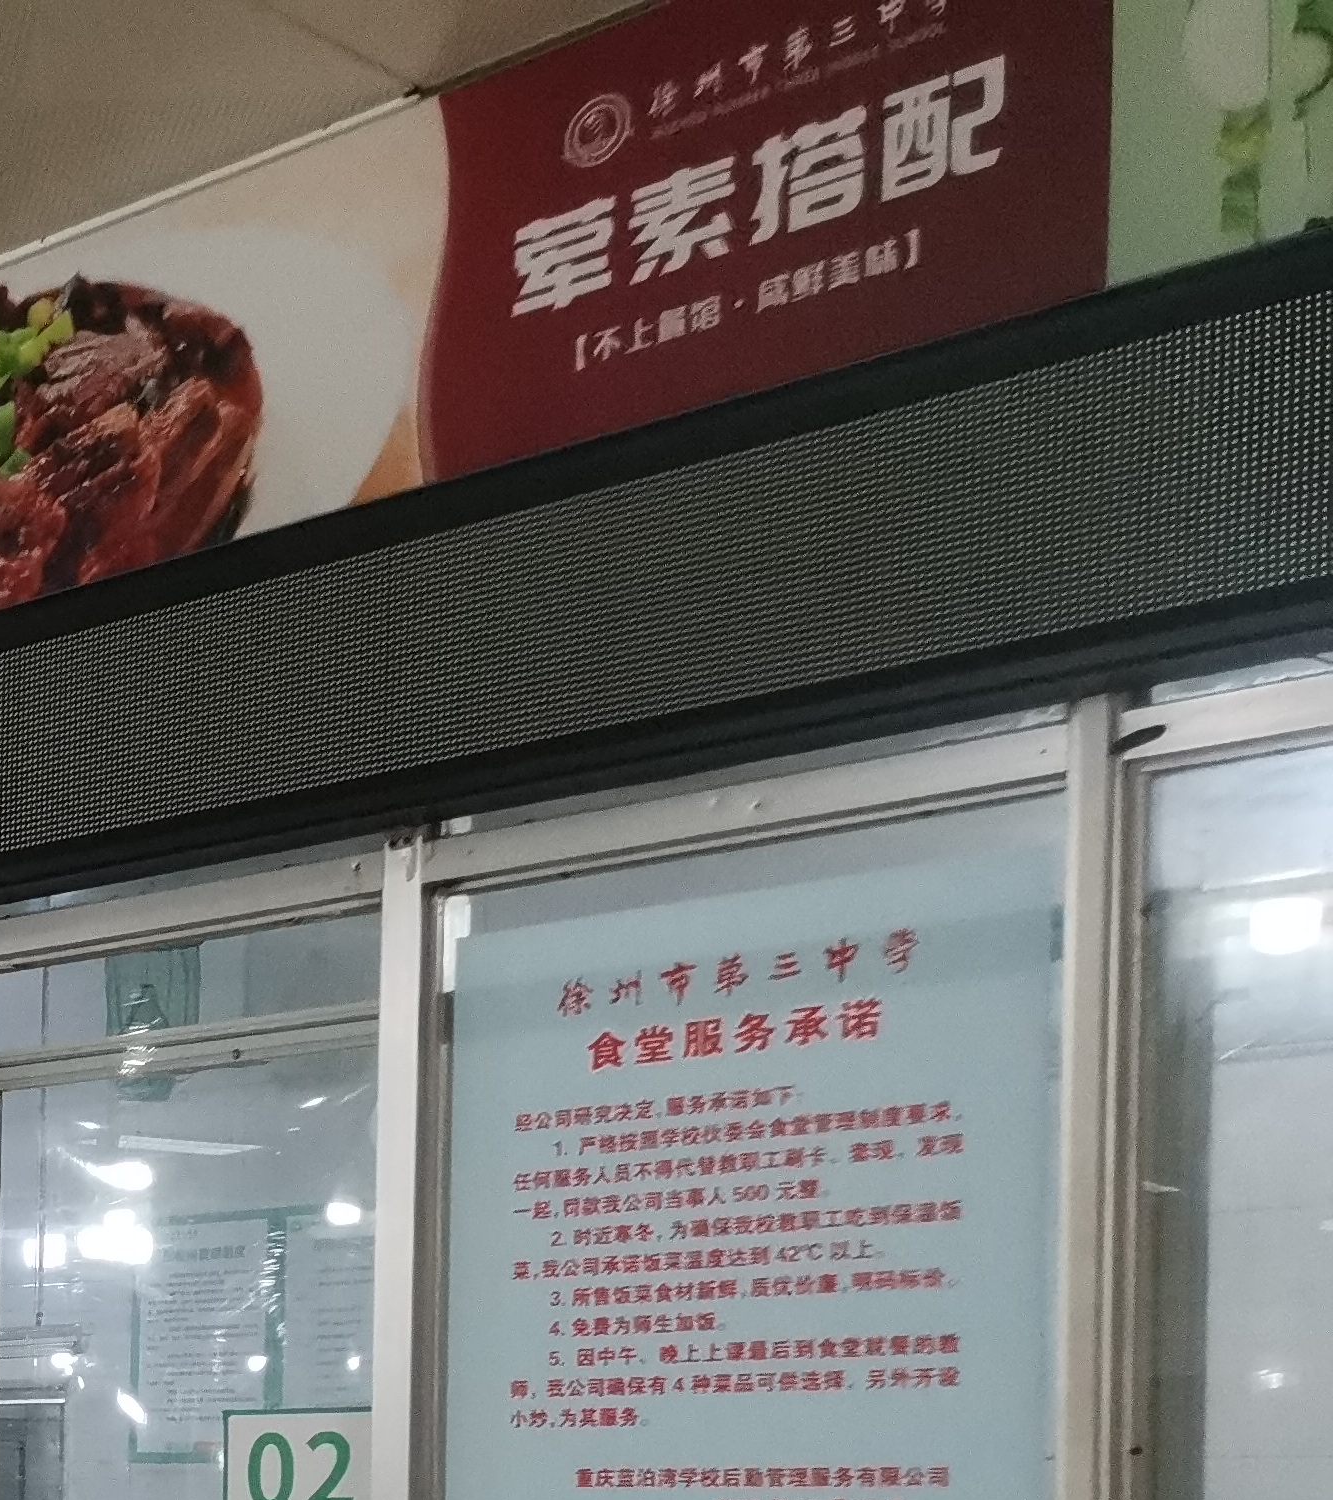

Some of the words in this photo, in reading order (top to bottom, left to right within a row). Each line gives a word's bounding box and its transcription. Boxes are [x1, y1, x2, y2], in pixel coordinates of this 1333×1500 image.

[512, 54, 1007, 317] 荤素搭配
[556, 926, 920, 1018] 徐州市第三中学
[587, 997, 883, 1072] 食堂服务承诺
